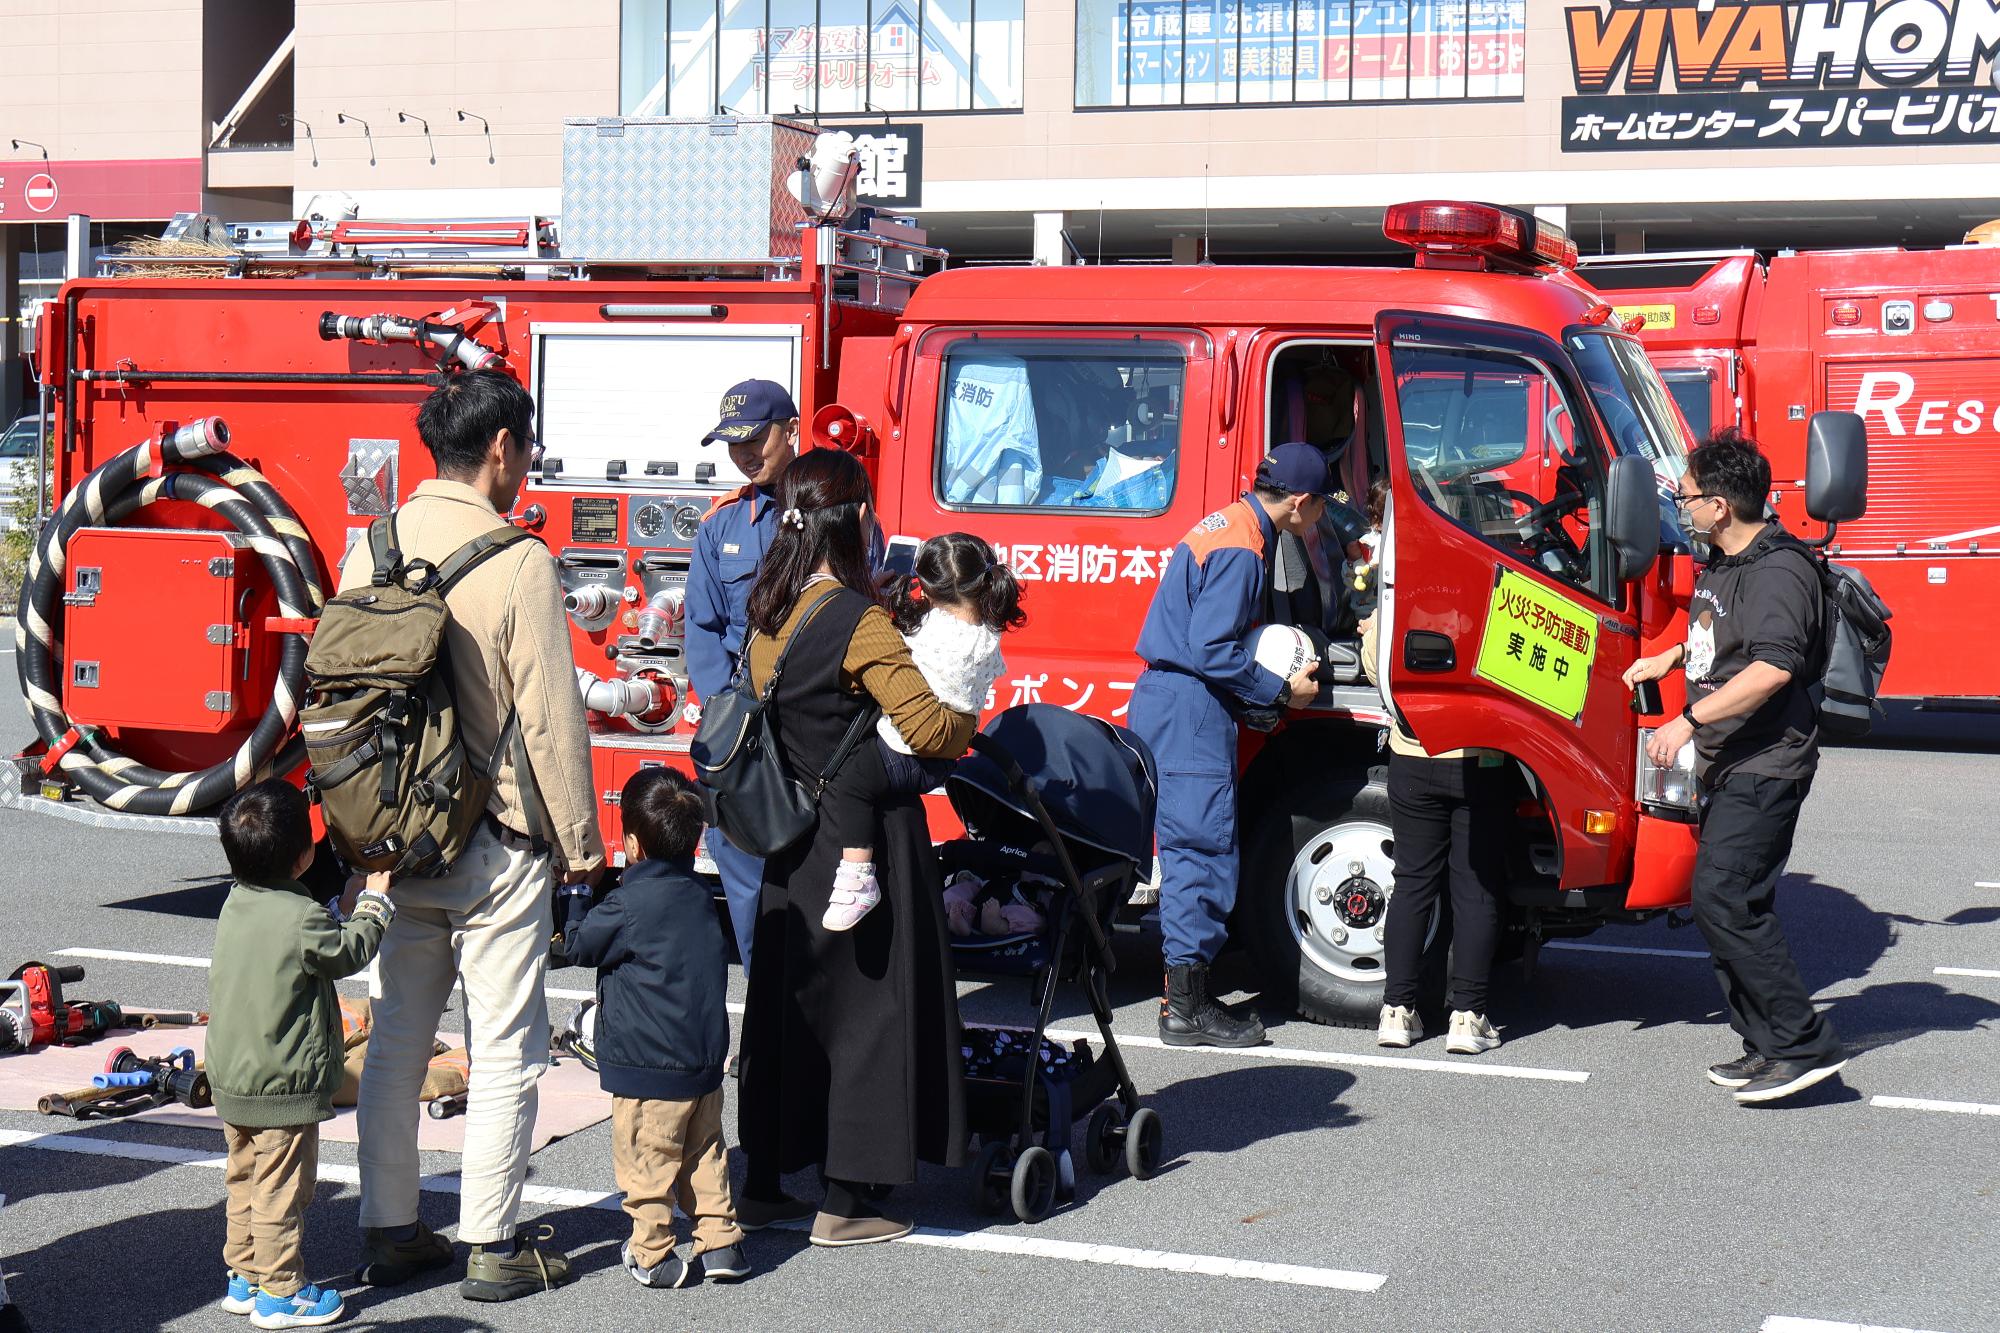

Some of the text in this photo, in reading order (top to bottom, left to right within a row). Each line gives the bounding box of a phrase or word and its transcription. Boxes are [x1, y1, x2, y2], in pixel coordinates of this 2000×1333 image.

[1123, 5, 1211, 38] 冷蔵庫
[1224, 1, 1316, 35] 洗濯機
[1329, 1, 1420, 29] エアコン
[1333, 43, 1415, 74] ゲーム
[1439, 39, 1525, 71] おもちゃ
[753, 58, 941, 91] トータルリフォーム
[1570, 109, 1757, 142] ホームセンター
[854, 133, 908, 198] 館
[1399, 333, 1421, 341] HINO
[720, 395, 747, 408] OFU
[1854, 371, 2000, 436] RES
[1498, 588, 1590, 655] 火災予防運動
[1506, 632, 1569, 681] 実施中
[1000, 845, 1028, 858] Aprica
